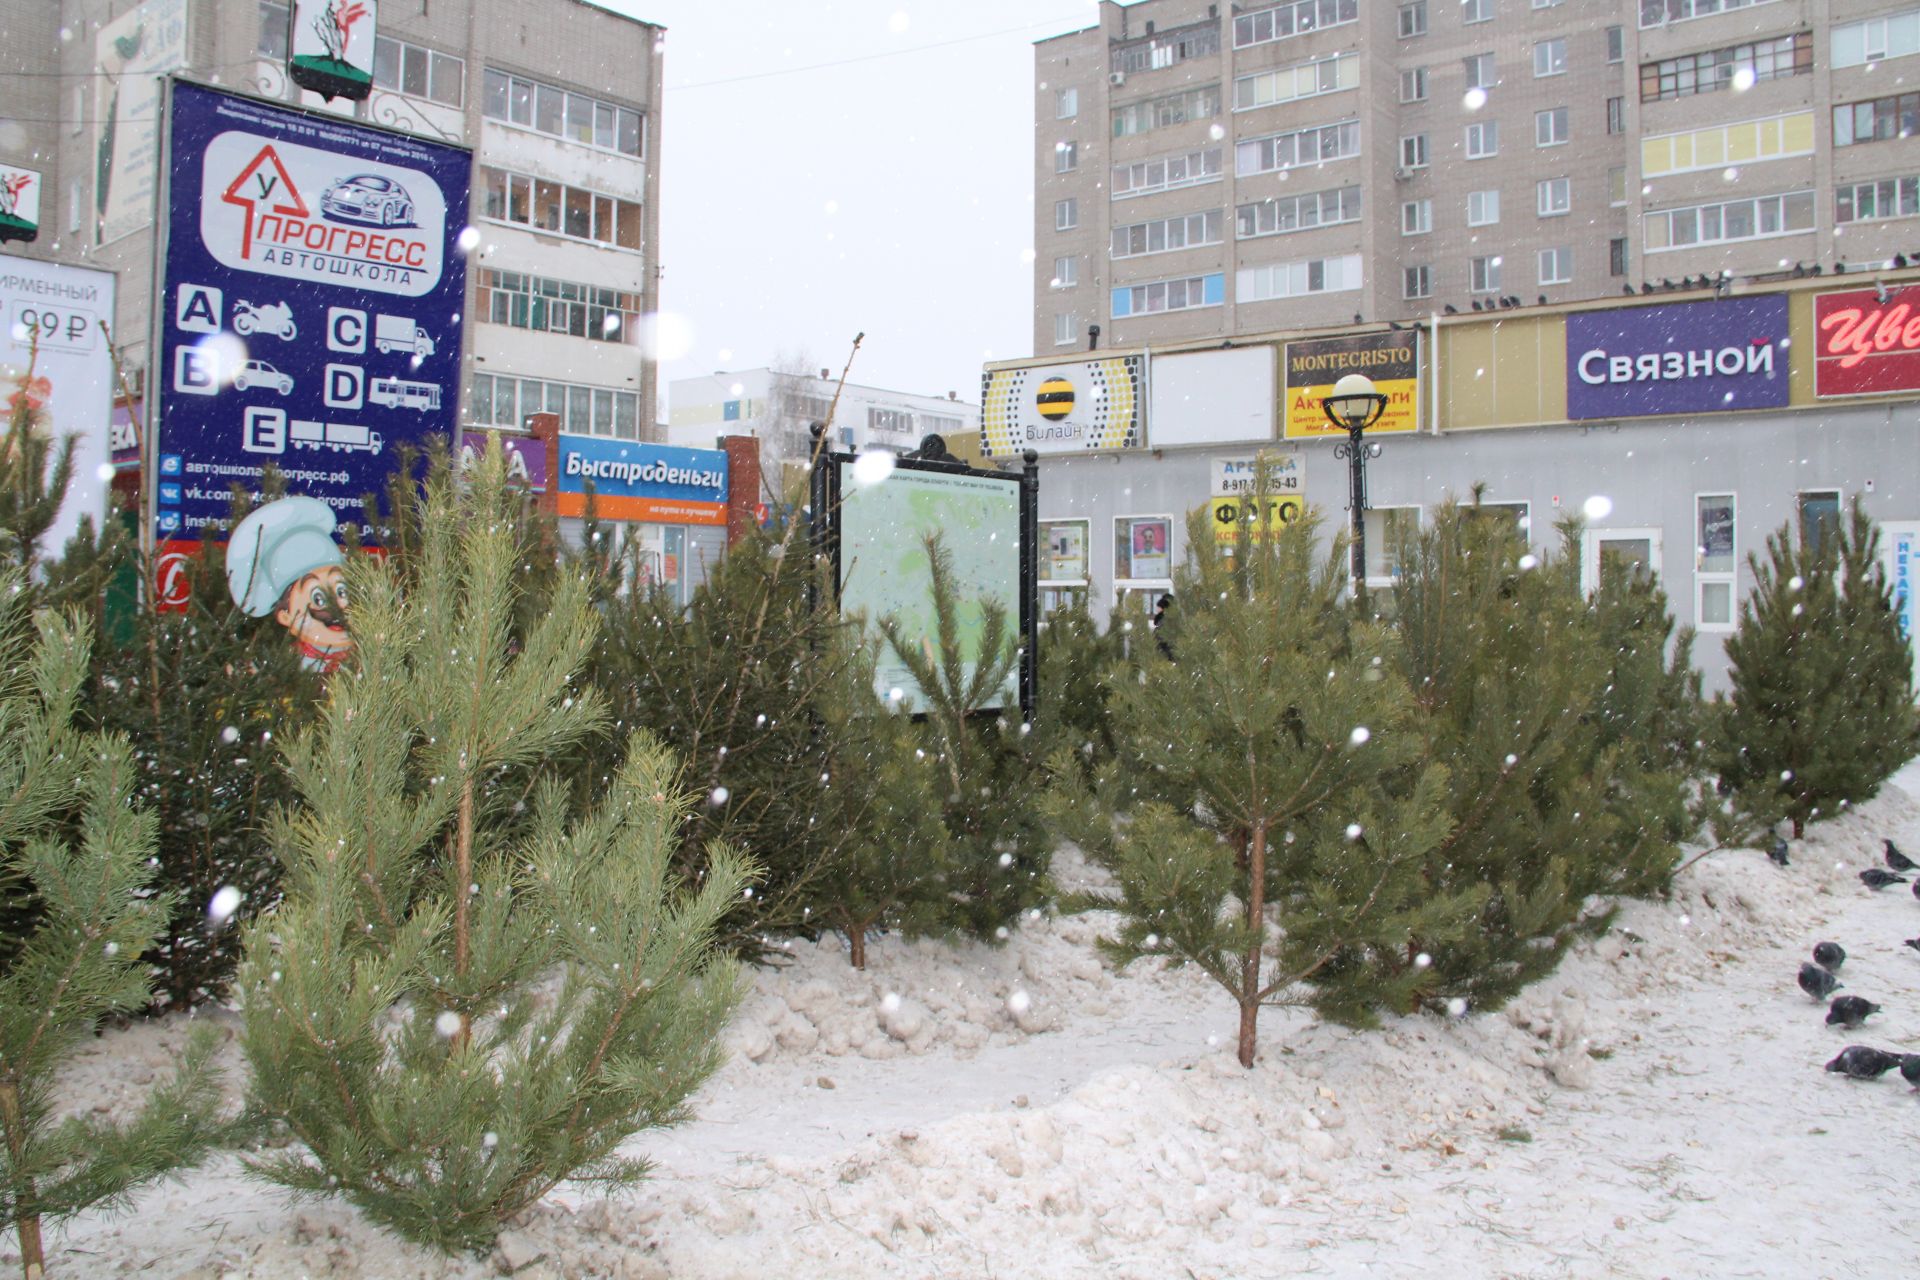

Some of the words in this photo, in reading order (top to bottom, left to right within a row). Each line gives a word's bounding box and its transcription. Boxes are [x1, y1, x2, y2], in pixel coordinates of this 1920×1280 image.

[257, 214, 426, 267] ПРОГРЕСС
[264, 248, 411, 285] АВТОШКОЛА
[333, 314, 362, 347] C
[1291, 347, 1411, 373] MONTECRISTO
[1577, 337, 1774, 384] Связной
[331, 370, 358, 402] D
[1026, 421, 1082, 441] Билайн
[566, 451, 724, 489] Быстроденьги
[1224, 459, 1297, 474] АРЕДА
